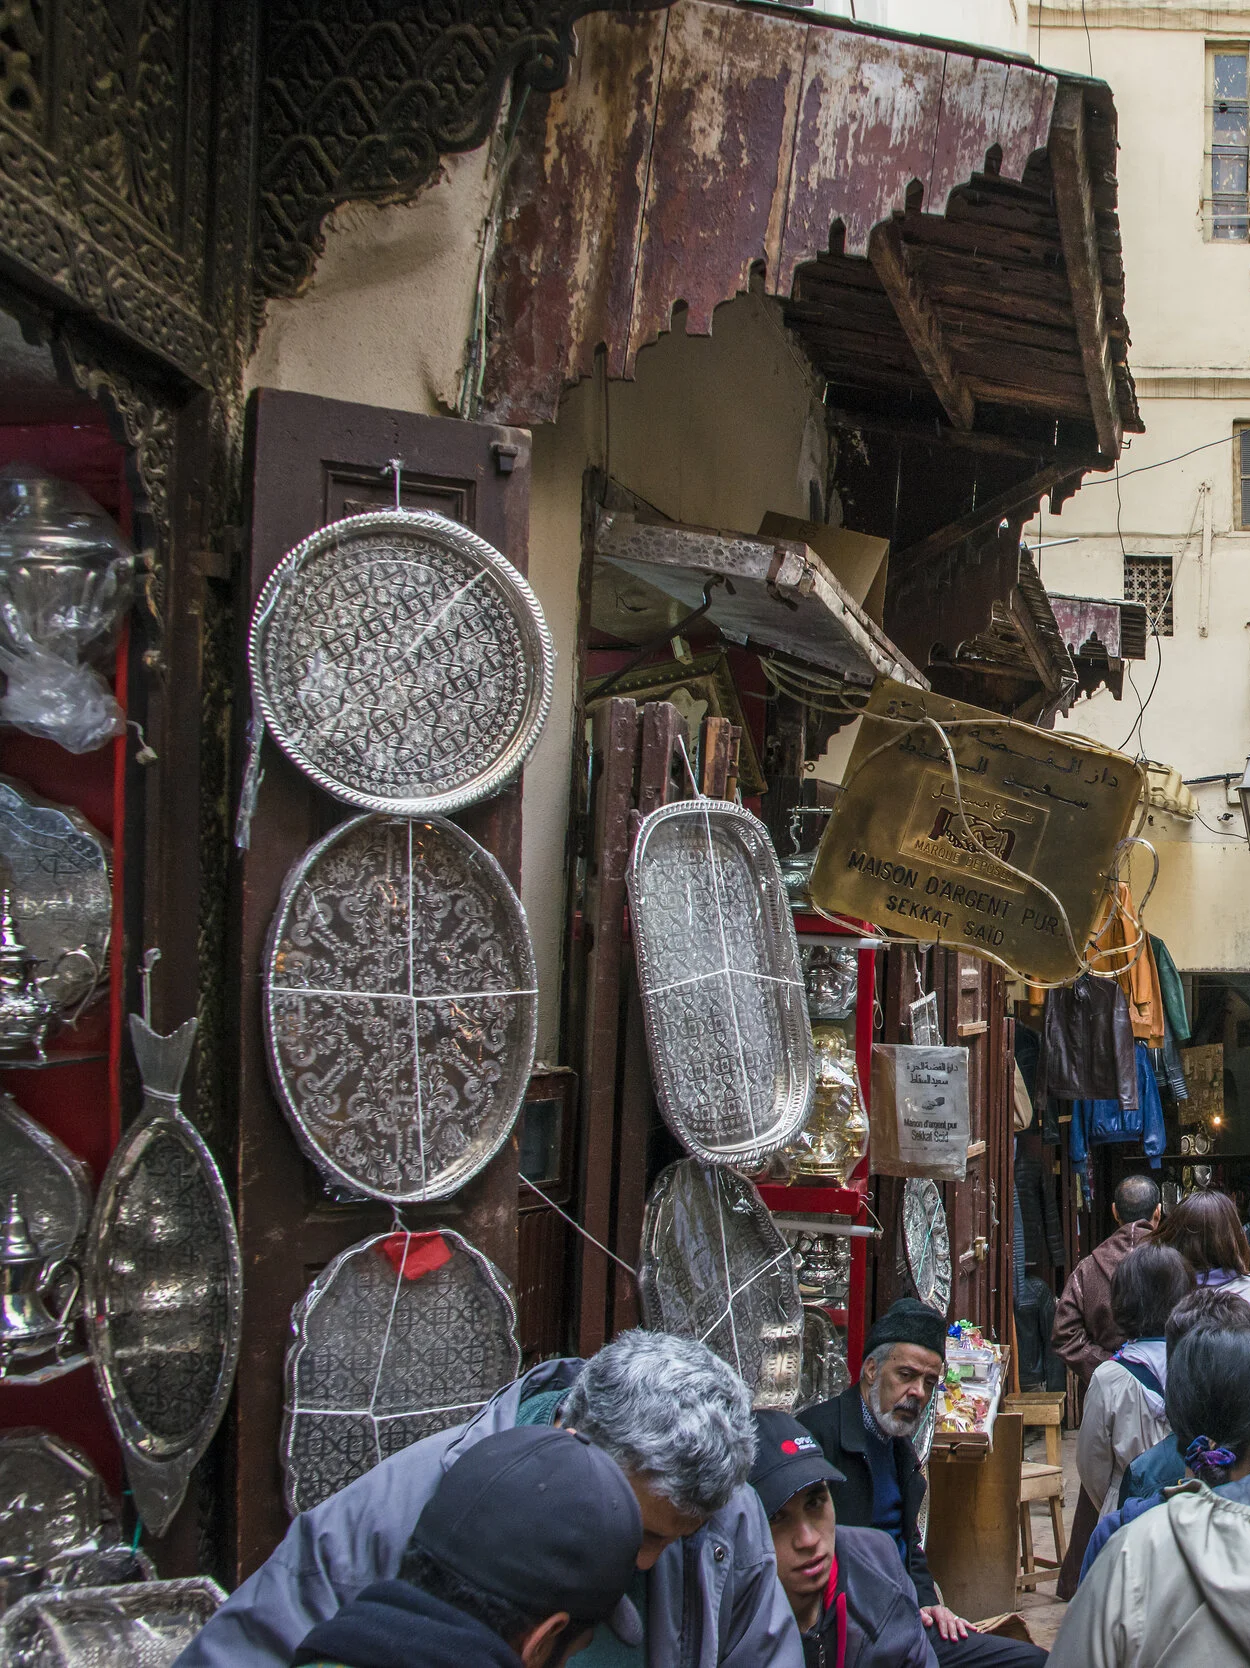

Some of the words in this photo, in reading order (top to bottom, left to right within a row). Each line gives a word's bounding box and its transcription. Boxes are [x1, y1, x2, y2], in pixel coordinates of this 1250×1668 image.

[915, 839, 961, 864] MARQUE
[848, 850, 918, 890] MAISON
[925, 876, 1013, 921] D'ARGENT
[886, 895, 953, 929] SEKKAT
[963, 920, 1005, 948] SAÏD
[904, 1118, 923, 1128] Maison
